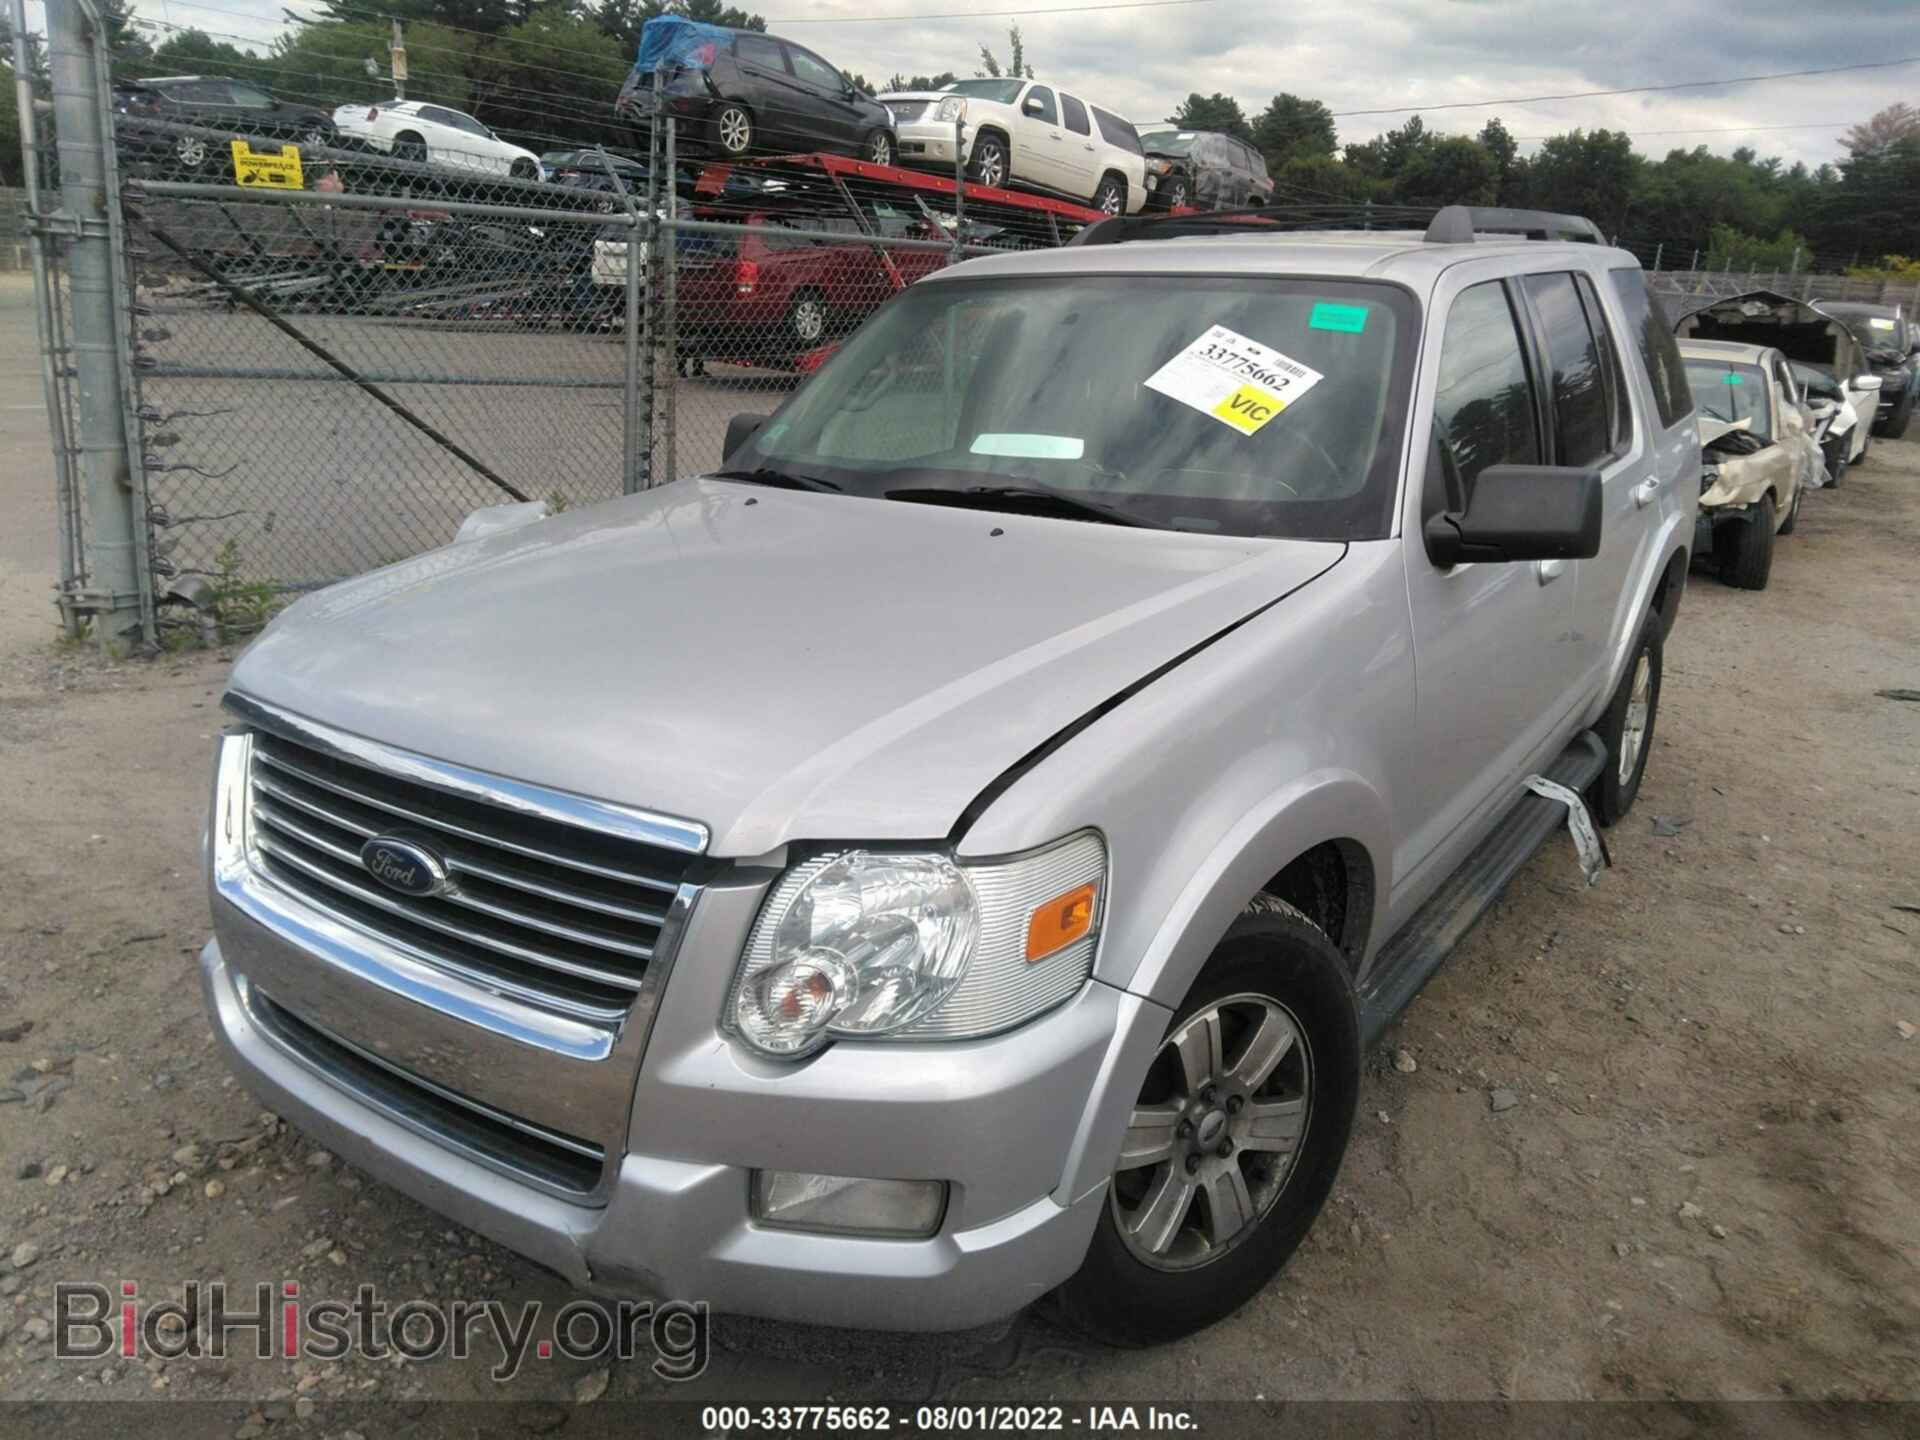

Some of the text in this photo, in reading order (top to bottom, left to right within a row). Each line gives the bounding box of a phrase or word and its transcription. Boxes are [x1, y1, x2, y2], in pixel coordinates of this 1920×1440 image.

[1200, 343, 1290, 391] 33775662
[1230, 393, 1271, 421] VIC
[371, 848, 416, 886] Ford
